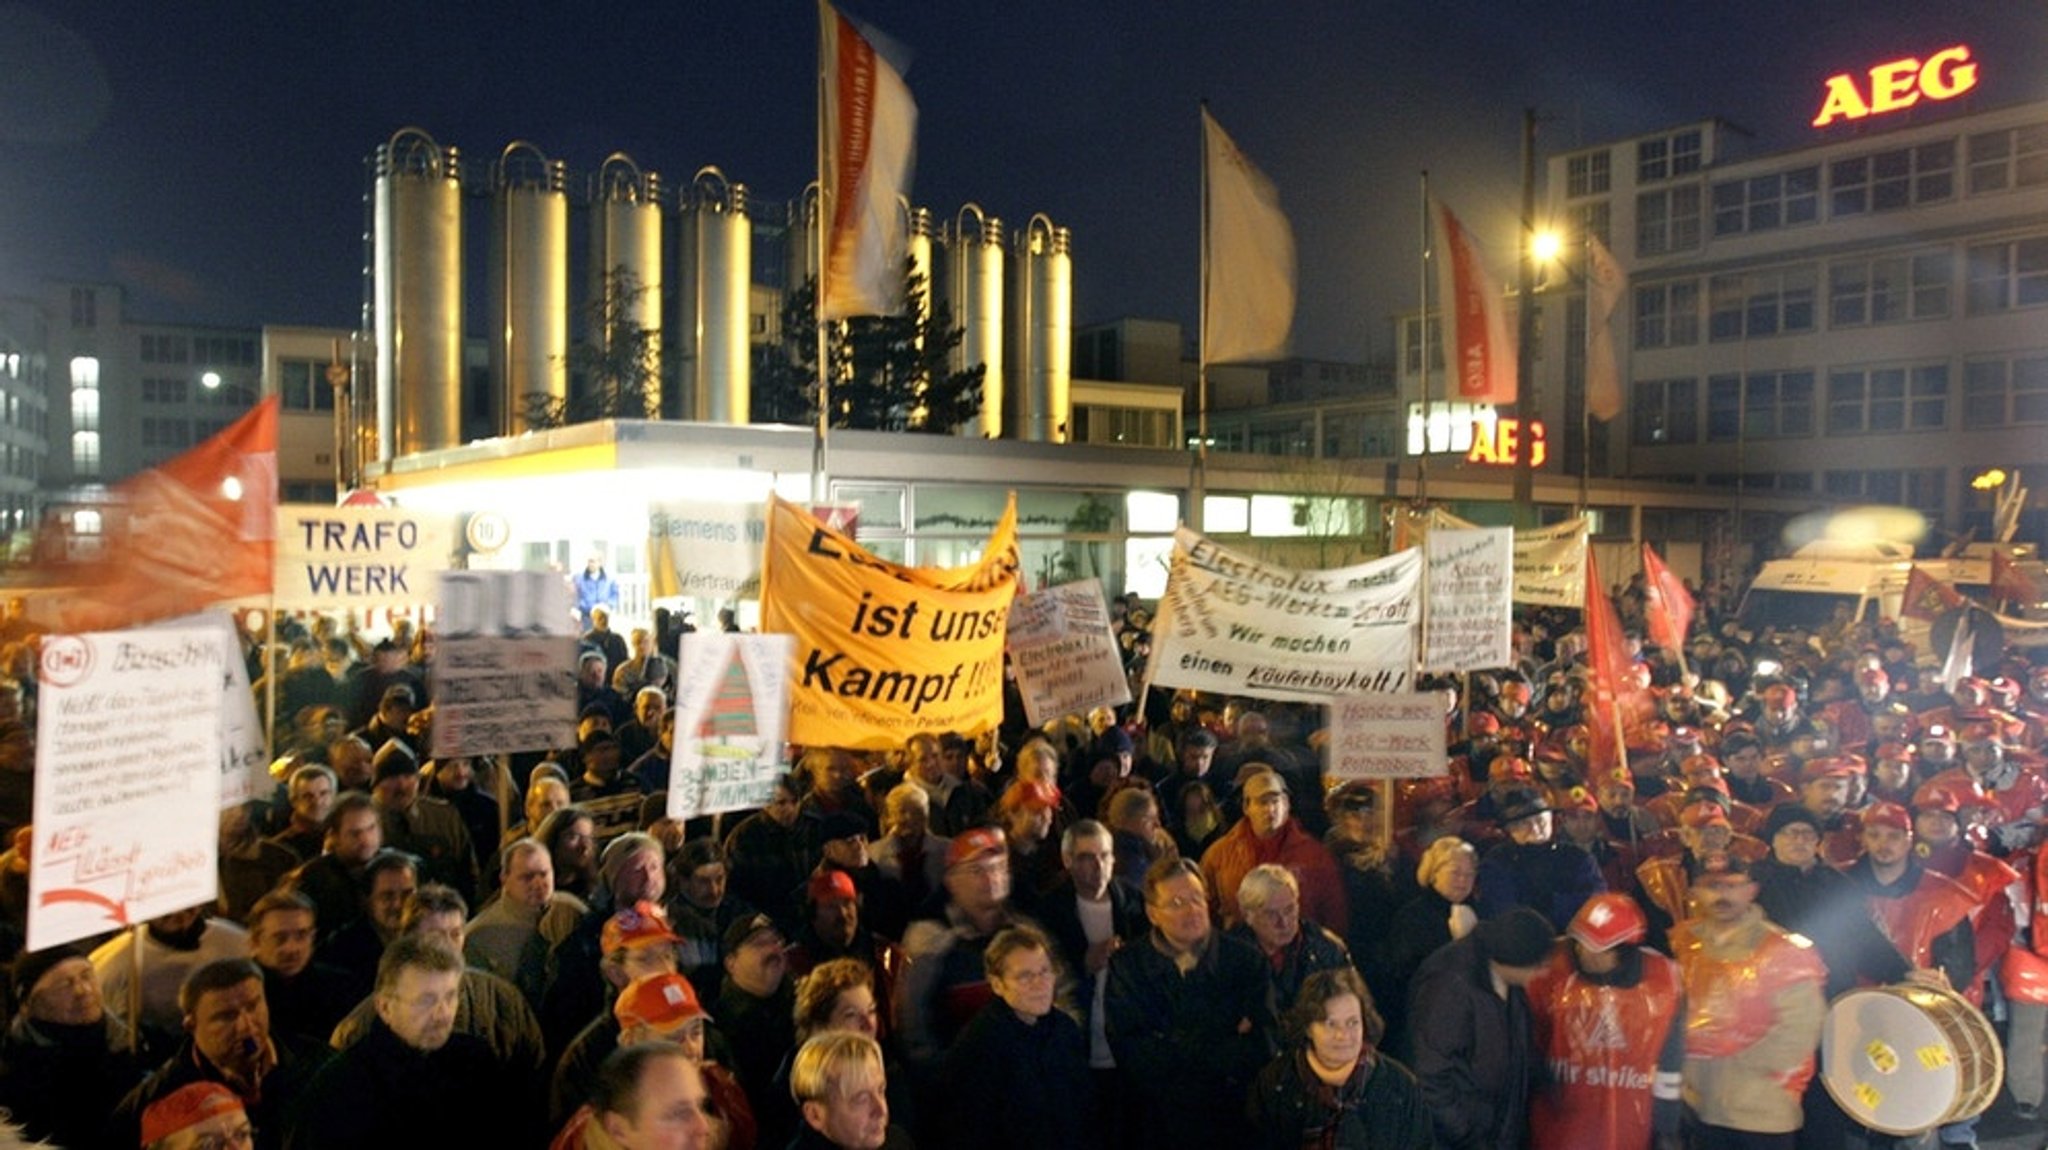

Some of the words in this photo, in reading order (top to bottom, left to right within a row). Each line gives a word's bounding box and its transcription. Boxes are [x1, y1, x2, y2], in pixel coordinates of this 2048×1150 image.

[1812, 45, 1978, 127] AEG
[298, 520, 418, 551] TRAFO
[650, 512, 737, 543] Siemens
[307, 564, 410, 595] WERK
[1190, 540, 1332, 594] Electrolux
[1518, 584, 1565, 598] Nürnberg
[850, 591, 918, 640] ist
[1228, 621, 1265, 644] Wir
[1270, 632, 1352, 654] machen
[1179, 651, 1234, 677] einen
[803, 648, 964, 714] Kampf
